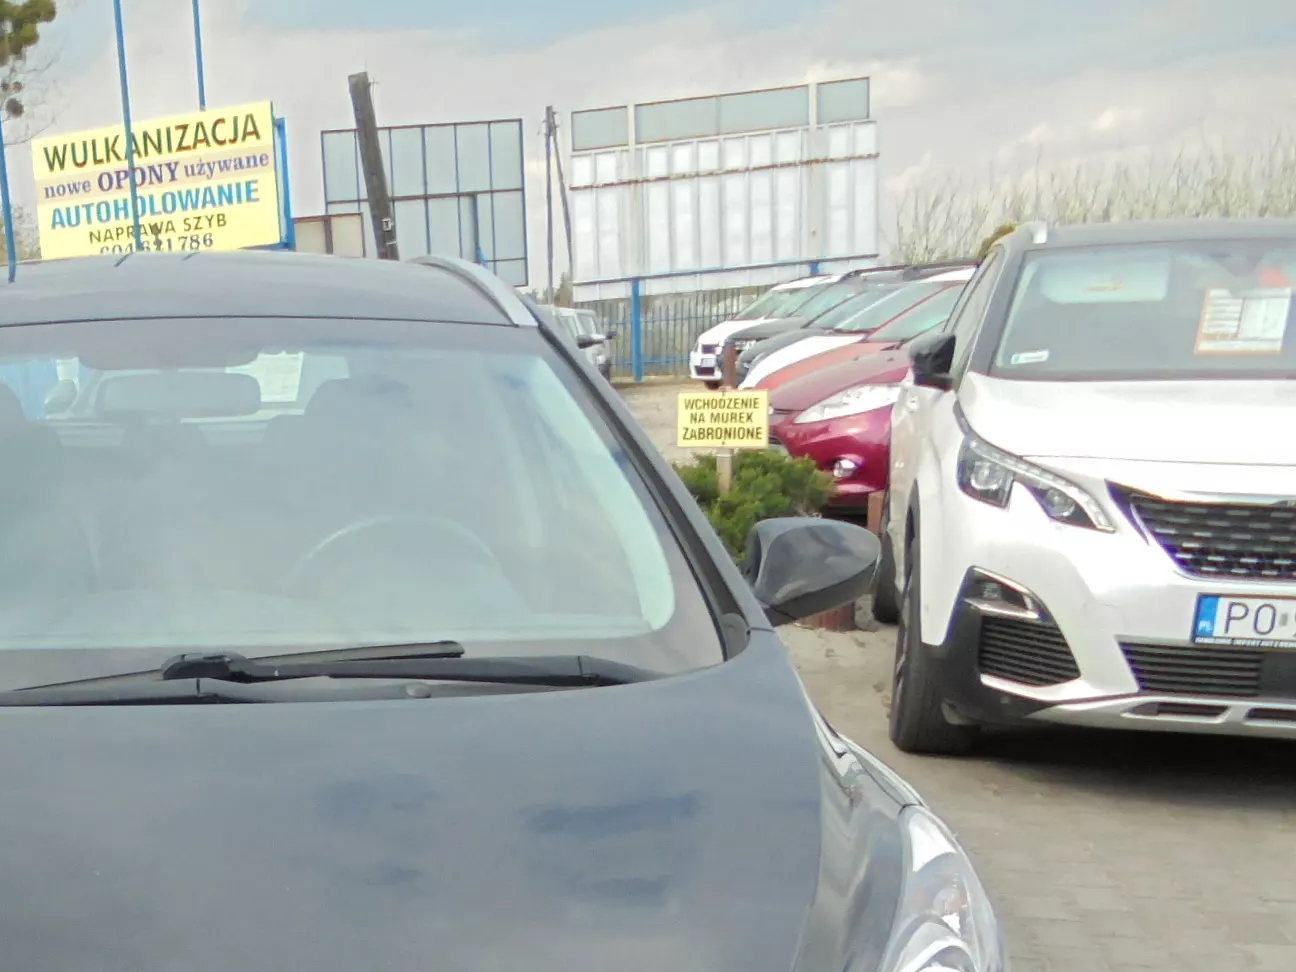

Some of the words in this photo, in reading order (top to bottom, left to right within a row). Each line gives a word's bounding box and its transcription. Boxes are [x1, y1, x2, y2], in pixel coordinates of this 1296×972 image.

[43, 113, 261, 172] WULKANIZACJA
[44, 179, 91, 199] nowe
[97, 160, 179, 193] OPONY
[184, 152, 269, 180] używane
[51, 178, 260, 230] AUTOHOLOWANIE
[89, 220, 176, 244] NAPRAWA
[183, 213, 227, 232] SZYB
[684, 397, 760, 411] WCHODZENIE
[690, 412, 705, 424] NA
[710, 411, 754, 424] MUREK
[682, 426, 763, 440] ZABRONIONE
